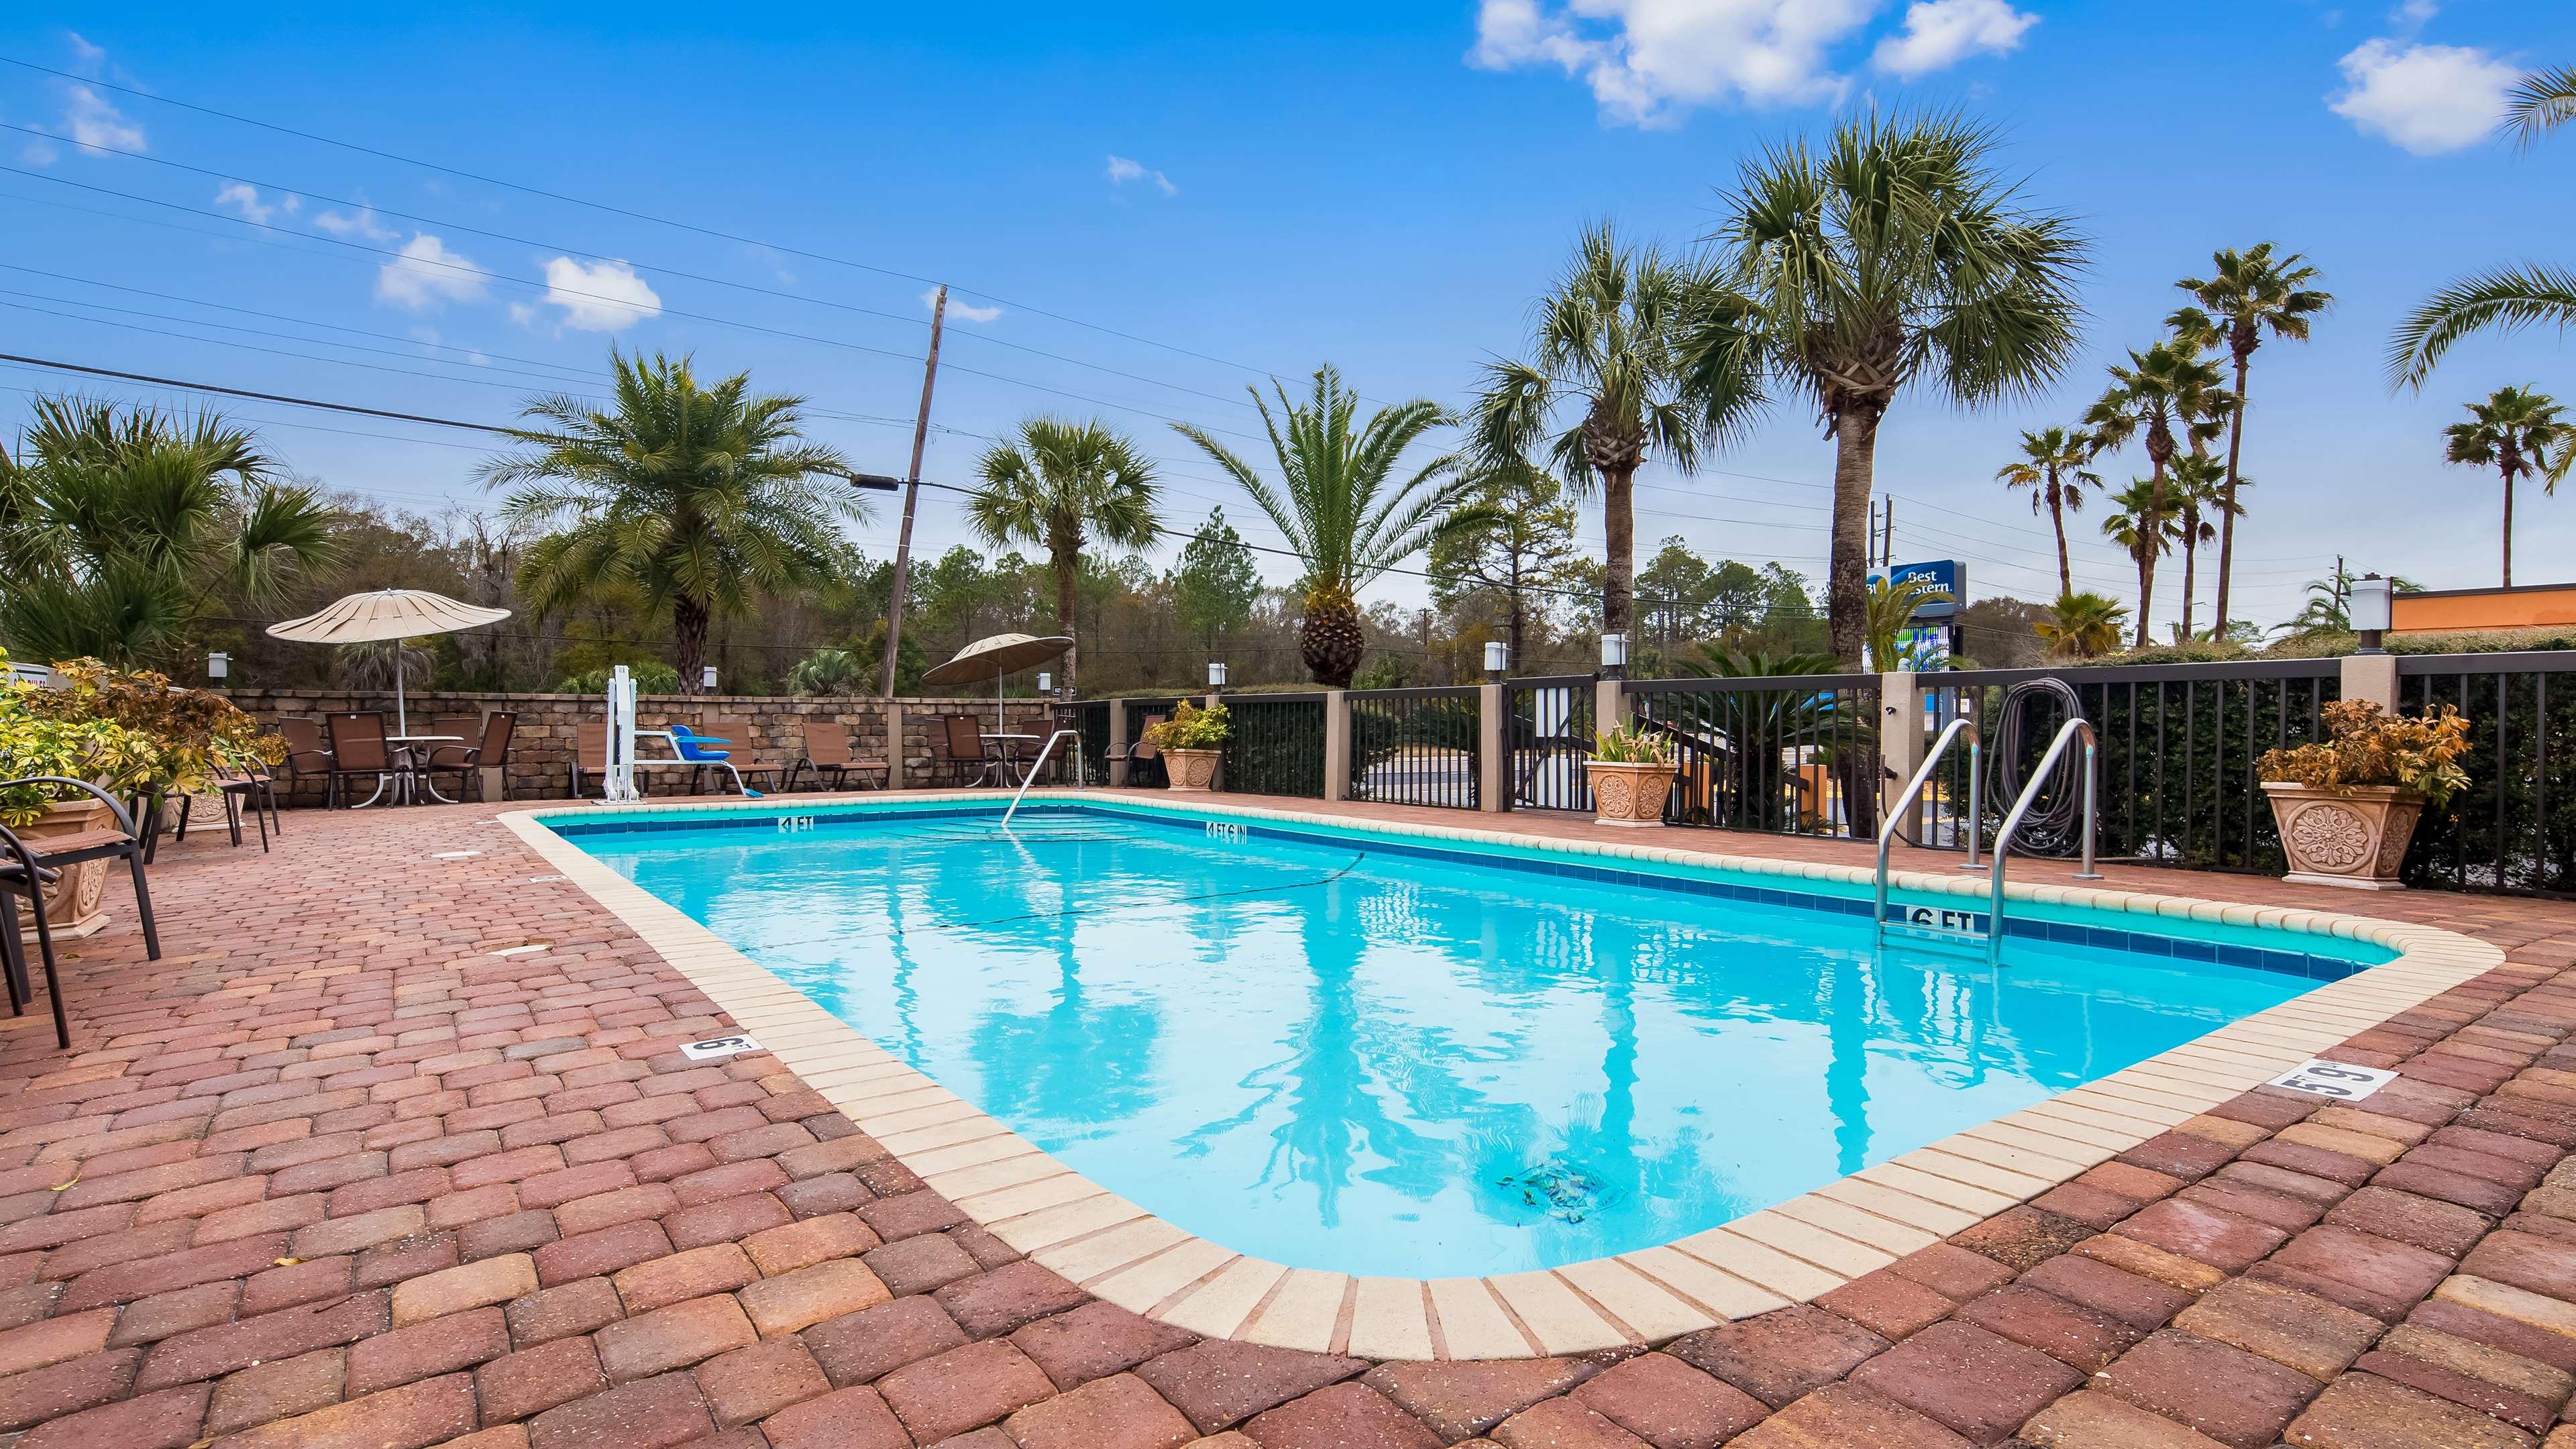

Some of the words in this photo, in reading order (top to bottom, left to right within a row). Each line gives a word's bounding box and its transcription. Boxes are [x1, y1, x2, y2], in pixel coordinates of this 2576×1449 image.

[1908, 570, 1937, 583] Best
[1237, 825, 1246, 835] IN
[1912, 908, 1933, 925] 6
[1941, 910, 1971, 930] FT
[2281, 1079, 2353, 1095] 5
